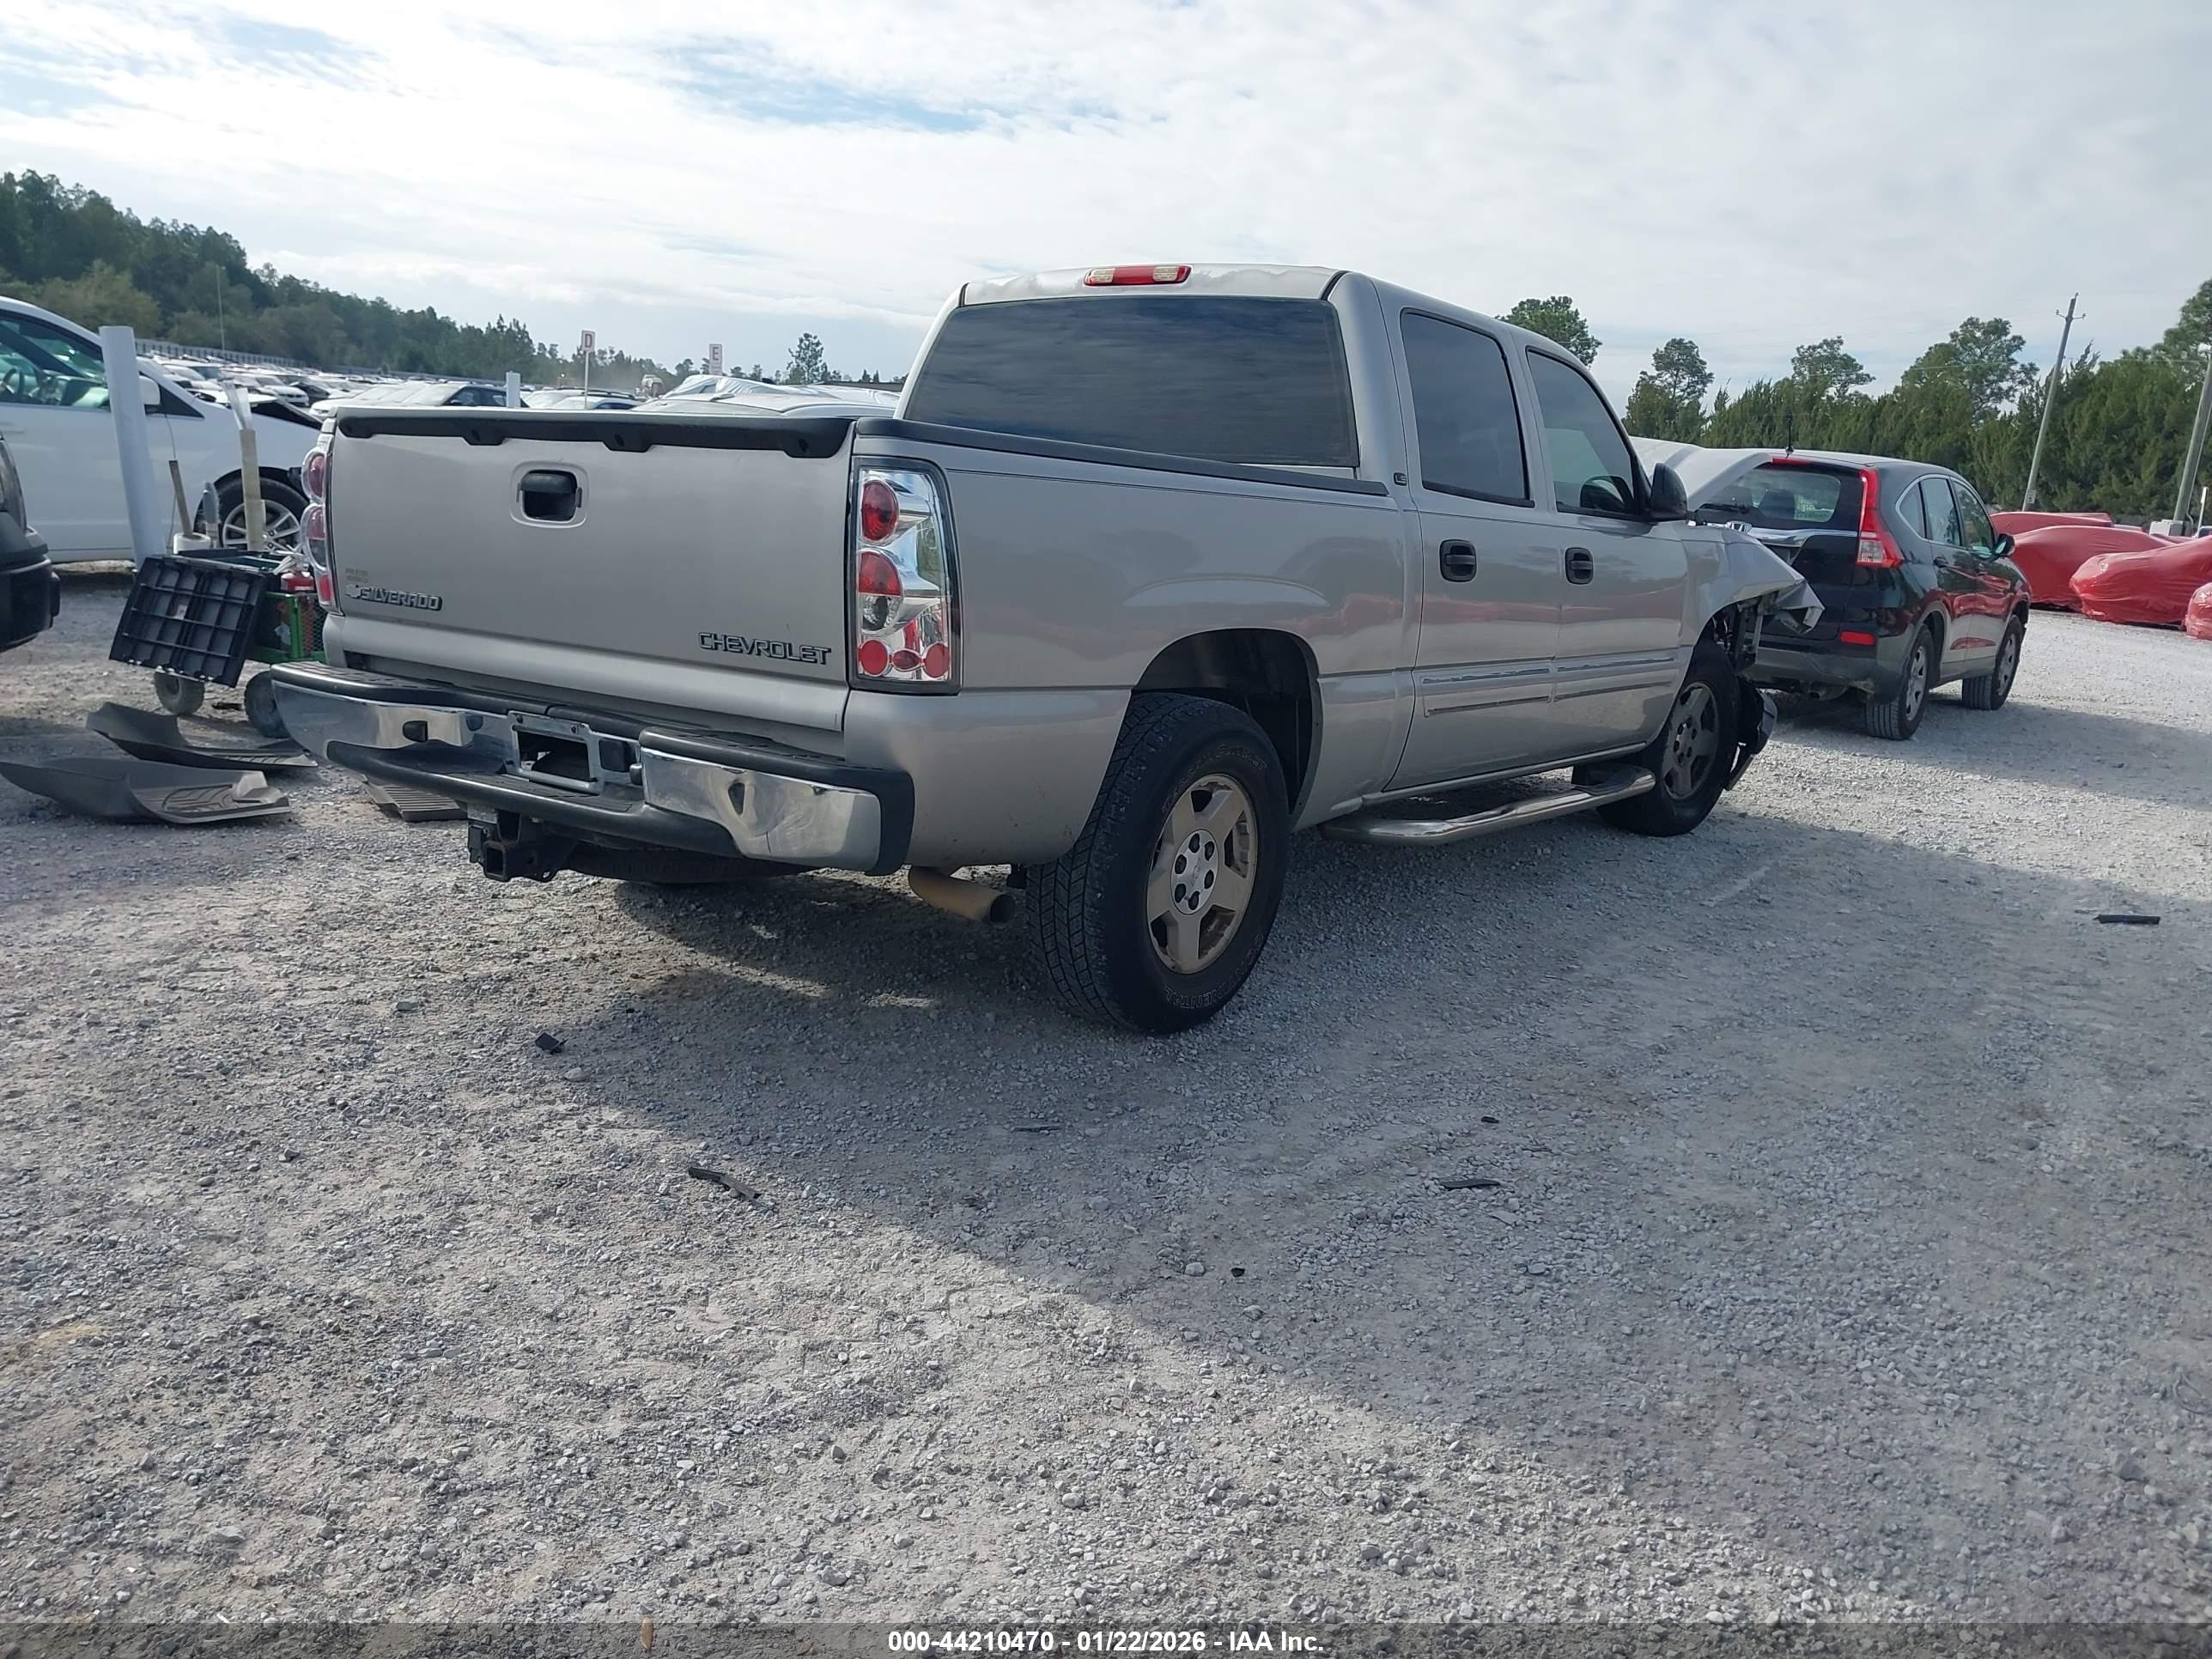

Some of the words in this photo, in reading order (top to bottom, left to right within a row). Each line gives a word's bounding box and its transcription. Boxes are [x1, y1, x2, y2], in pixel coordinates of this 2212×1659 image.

[585, 333, 592, 348] D
[713, 346, 719, 361] E
[360, 586, 441, 611] SILVERADO
[698, 632, 831, 665] CHEVROLET
